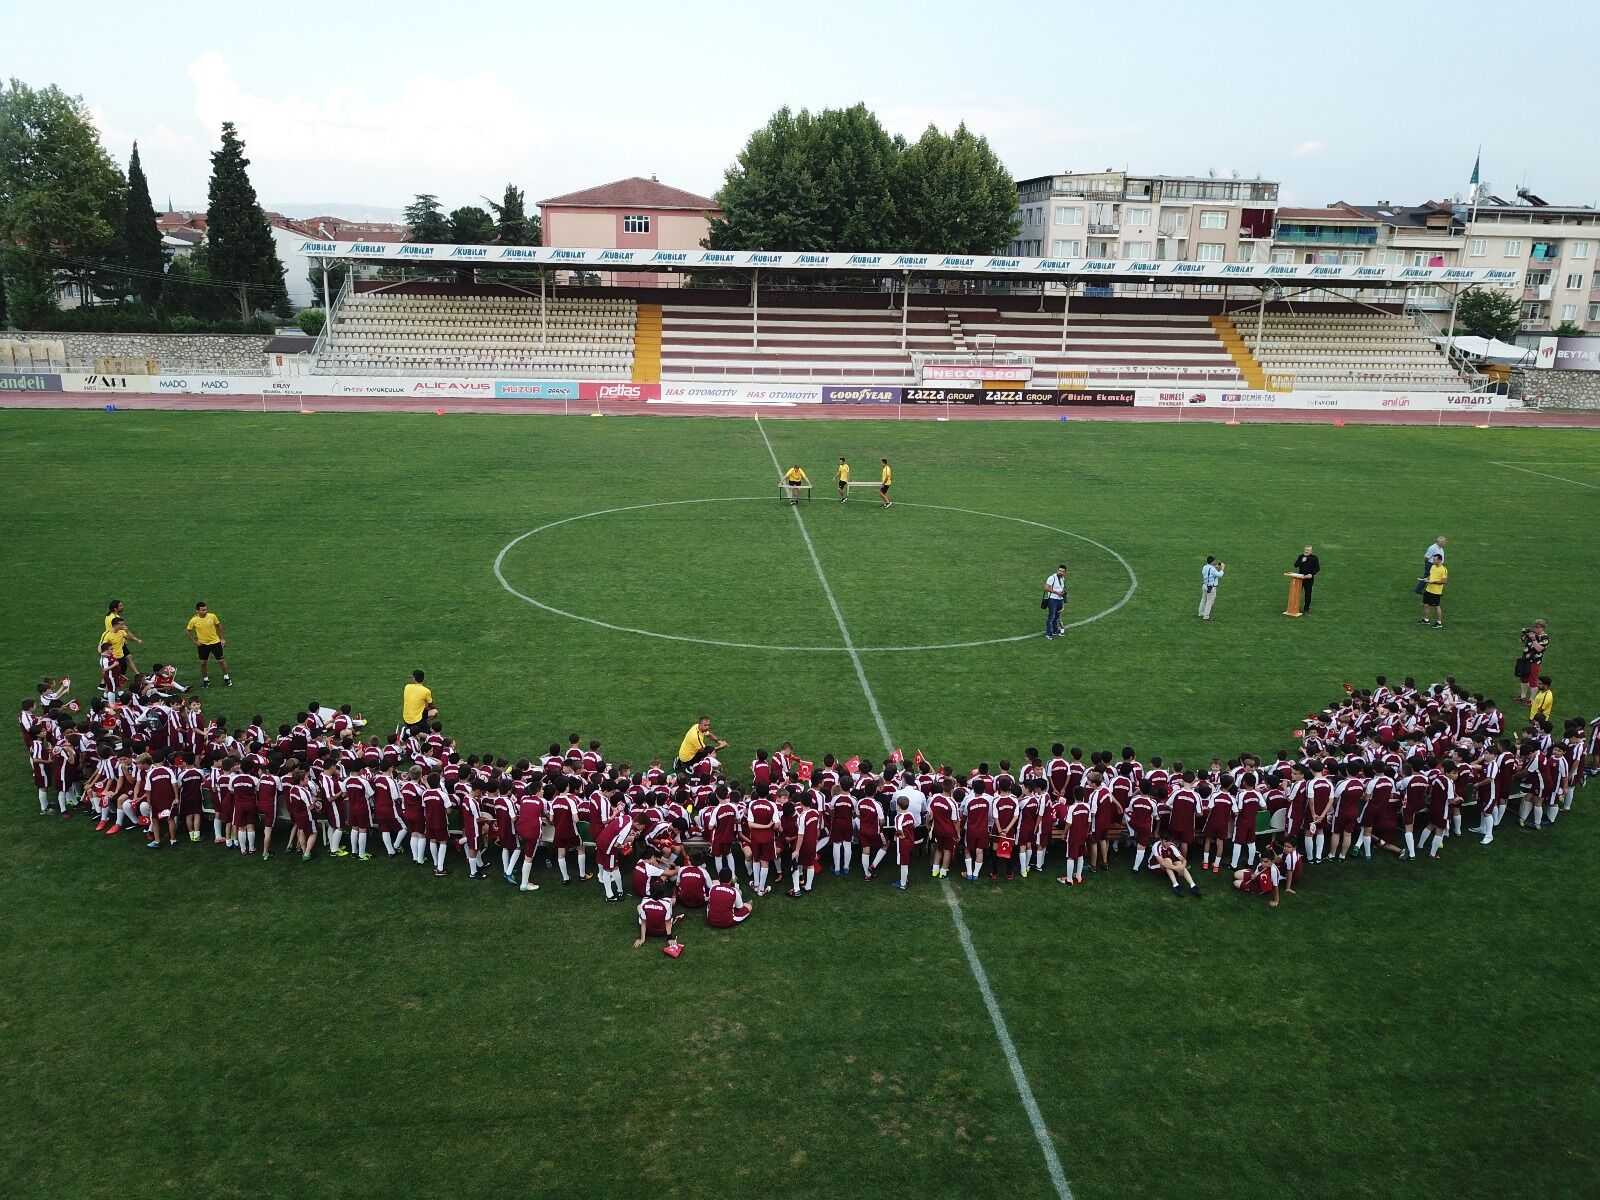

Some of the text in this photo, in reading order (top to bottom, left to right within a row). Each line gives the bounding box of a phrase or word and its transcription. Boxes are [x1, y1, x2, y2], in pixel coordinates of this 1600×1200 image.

[201, 380, 229, 388] MADO
[502, 386, 541, 394] HUZUR
[665, 388, 686, 396] HAS
[1026, 393, 1053, 401] GROUP
